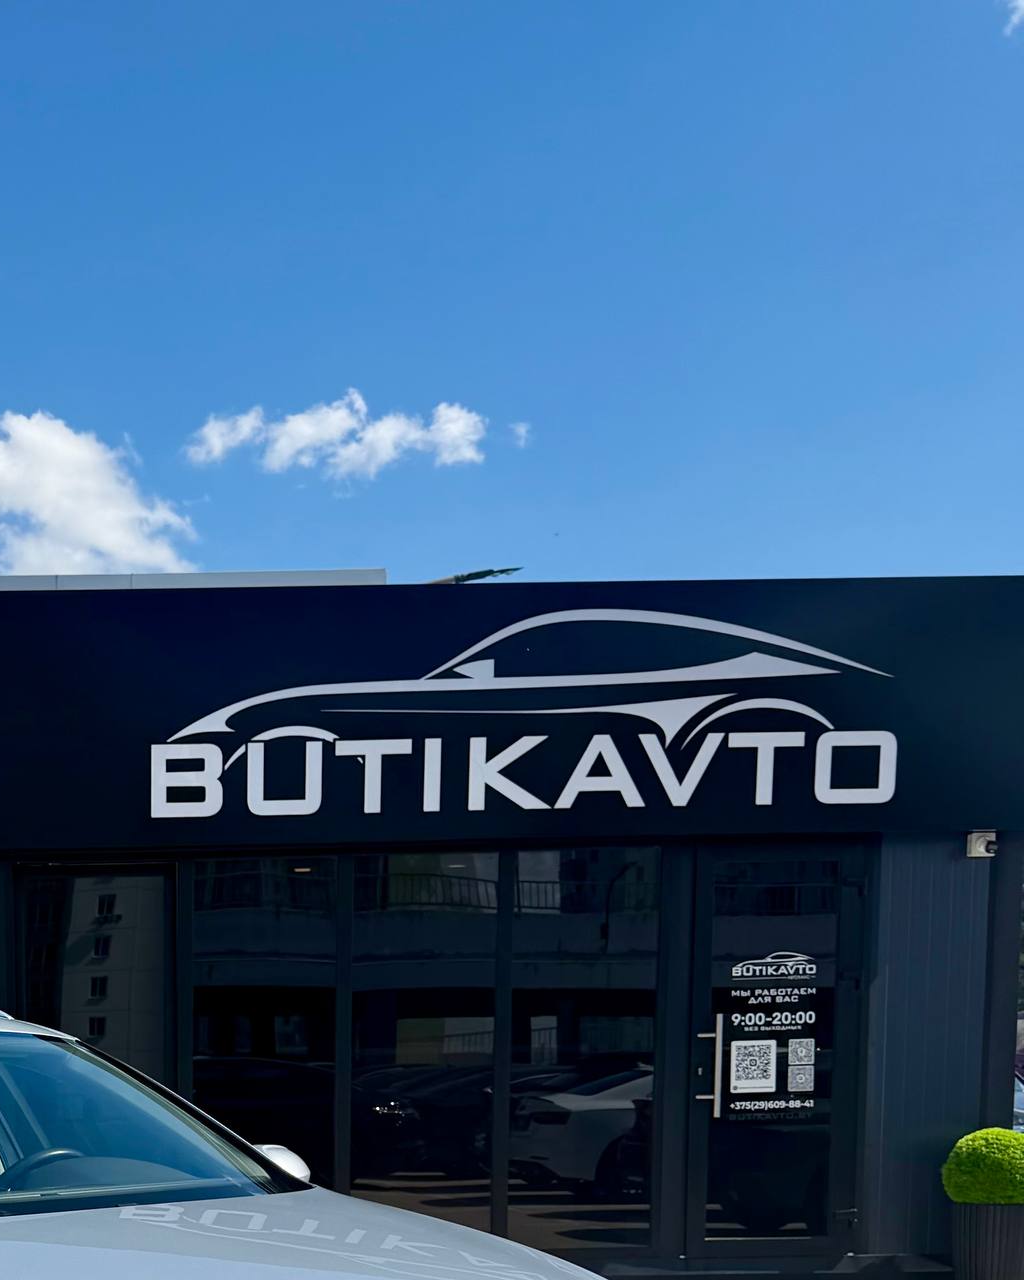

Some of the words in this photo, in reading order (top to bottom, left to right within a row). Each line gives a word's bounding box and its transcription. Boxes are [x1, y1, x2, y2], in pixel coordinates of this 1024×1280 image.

[150, 730, 898, 819] BUTIKAVTO
[731, 964, 817, 977] BUTIKAVTO
[731, 989, 751, 997] МЫ
[755, 987, 817, 997] РАБОТАЕМ
[748, 996, 772, 1004] ДЛЯ
[775, 995, 799, 1003] ВАС
[731, 1011, 816, 1026] 9:00-20:00
